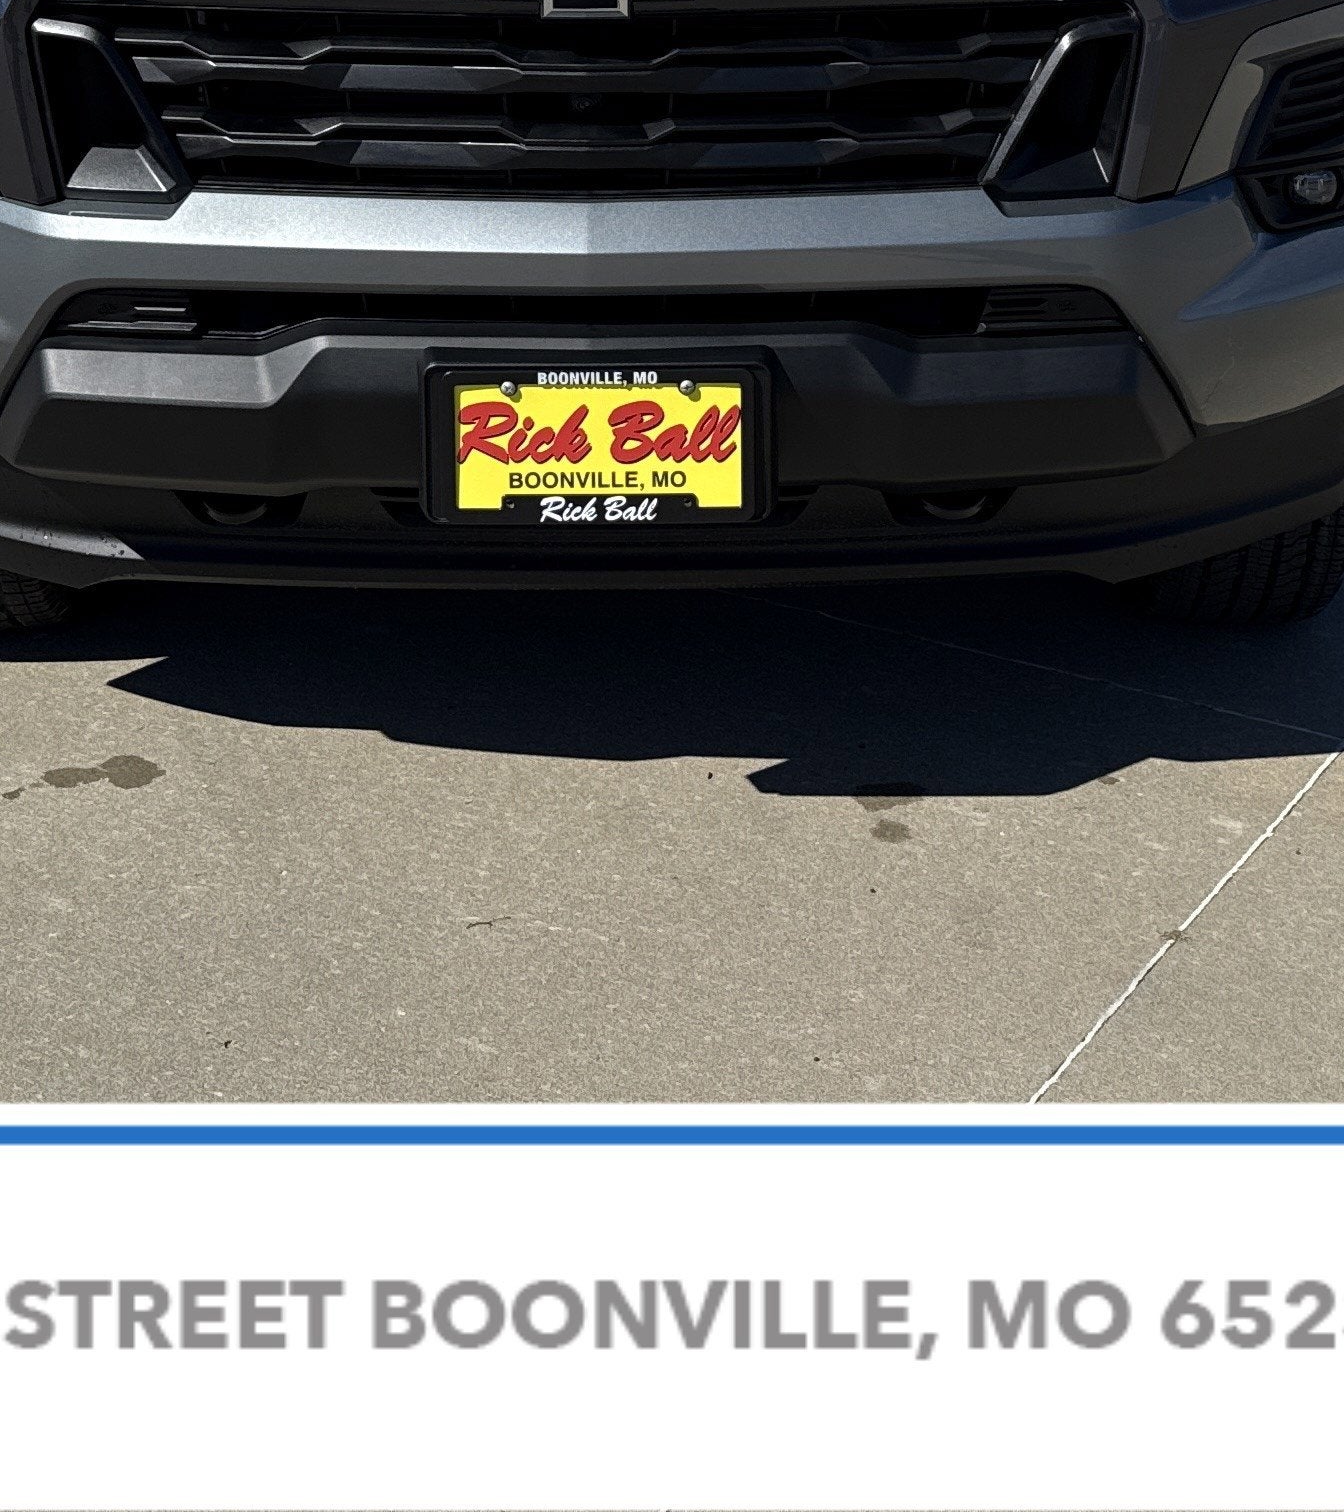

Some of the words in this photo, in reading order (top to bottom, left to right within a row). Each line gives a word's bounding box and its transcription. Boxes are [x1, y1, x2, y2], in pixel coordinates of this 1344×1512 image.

[536, 371, 628, 386] BOONVILLE,
[632, 370, 658, 385] MO
[457, 400, 593, 465] Rick
[607, 399, 742, 465] Ball
[508, 471, 646, 491] BOONVILLE,
[651, 470, 688, 488] MO
[539, 495, 598, 523] Rick
[603, 495, 658, 522] Ball
